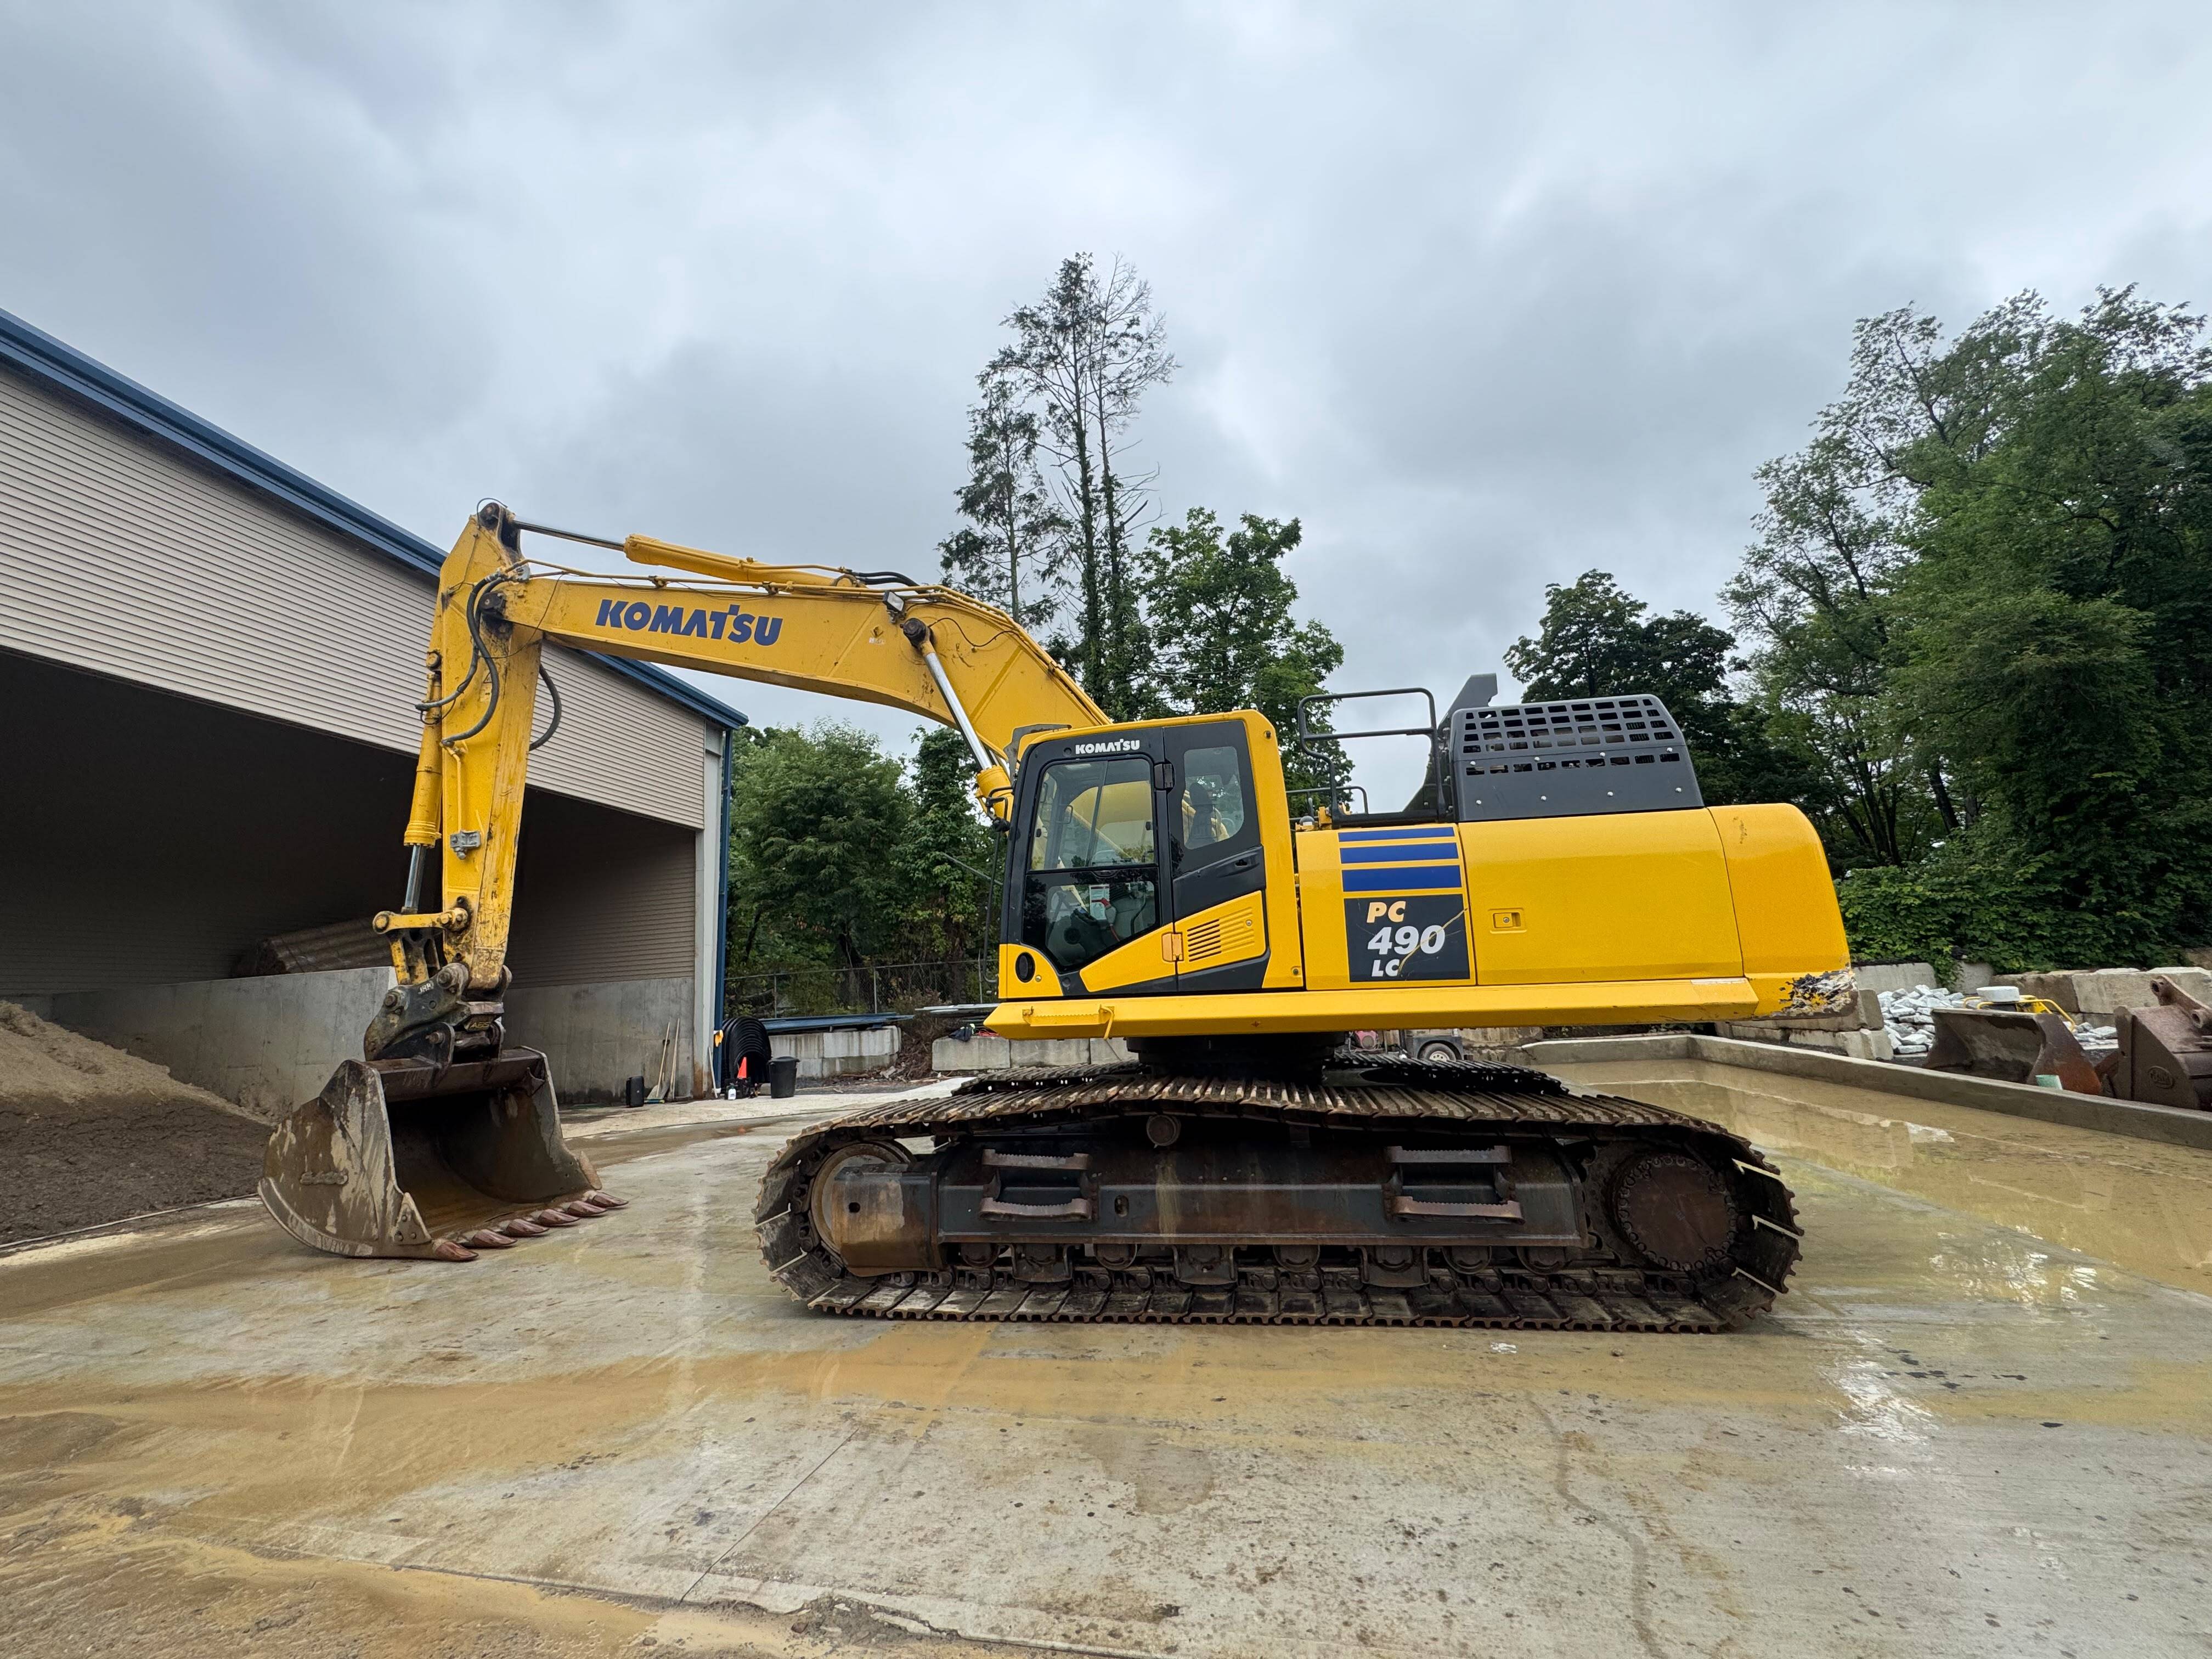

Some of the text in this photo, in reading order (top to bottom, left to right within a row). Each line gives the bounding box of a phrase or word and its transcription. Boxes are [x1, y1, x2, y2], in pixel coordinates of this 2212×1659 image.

[595, 599, 783, 646] KOMATSU
[1075, 738, 1140, 754] KOMATSU
[1367, 901, 1406, 923] PC
[1368, 925, 1445, 955] 490
[1372, 959, 1400, 977] LC
